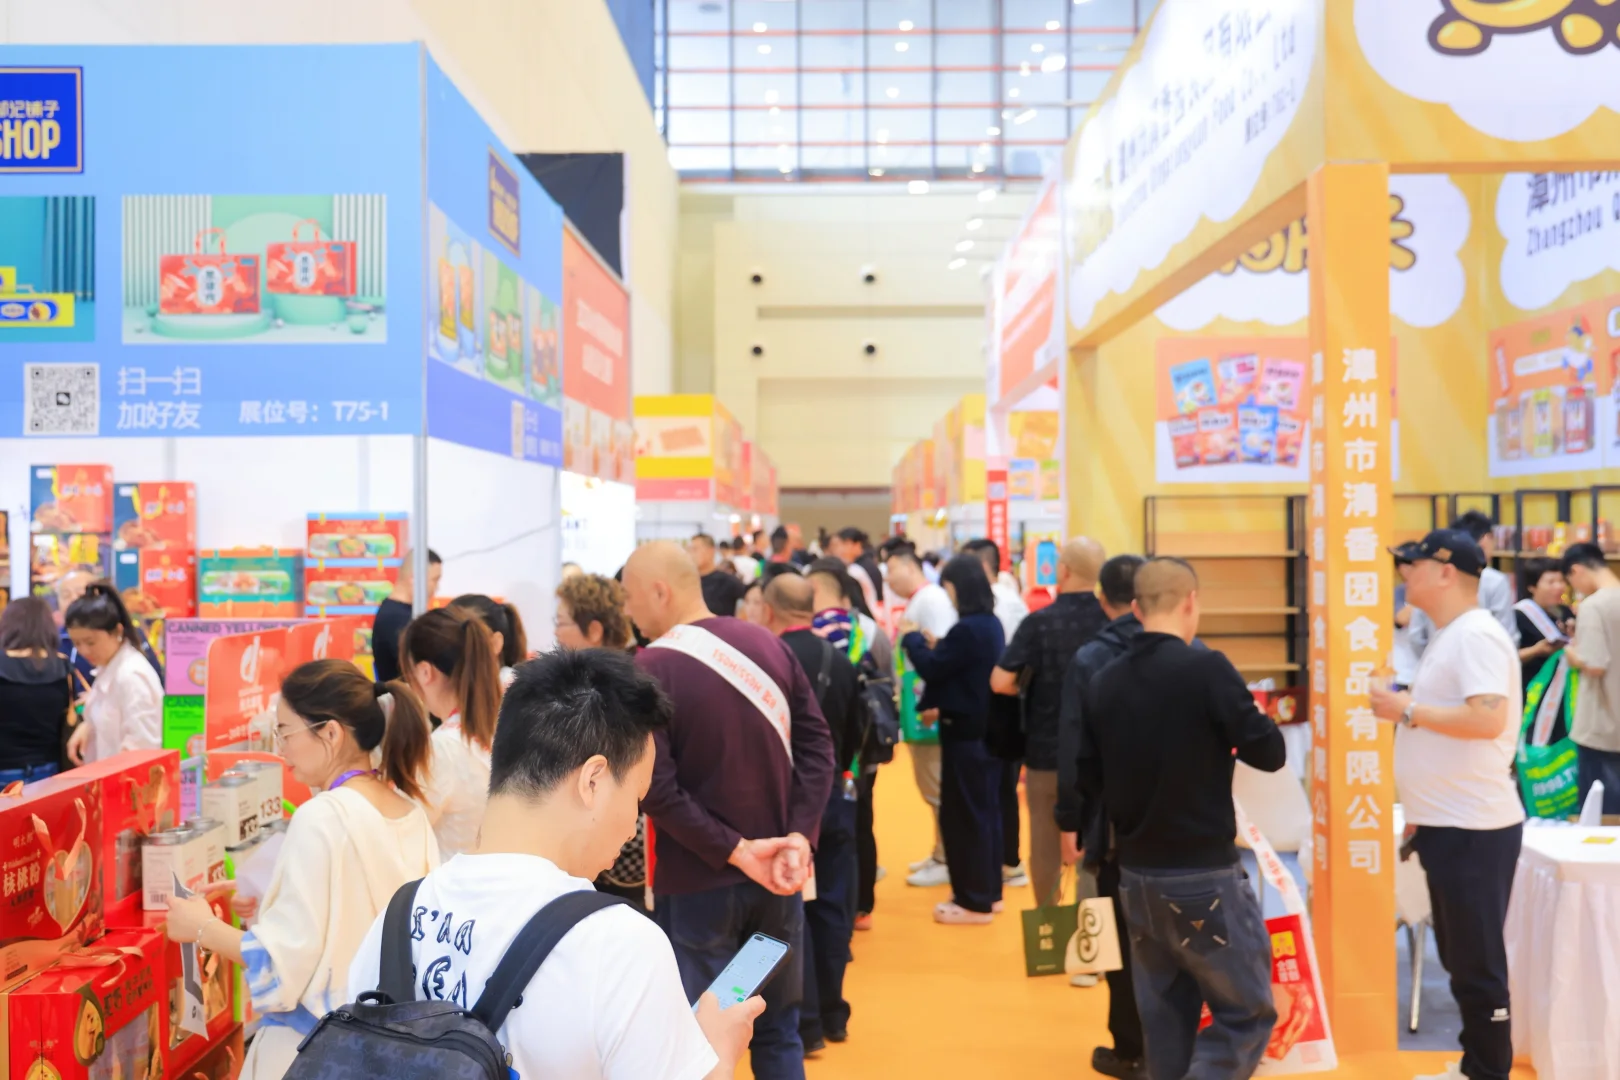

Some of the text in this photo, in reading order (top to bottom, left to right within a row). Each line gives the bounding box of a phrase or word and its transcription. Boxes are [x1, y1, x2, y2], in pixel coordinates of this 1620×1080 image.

[0, 119, 61, 159] HOP
[1526, 206, 1602, 256] Zhangzhou
[117, 366, 201, 396] 扫一扫
[116, 400, 202, 430] 加好友
[167, 622, 221, 634] CANNED
[261, 797, 281, 819] 133
[3, 862, 40, 897] 核桃粉
